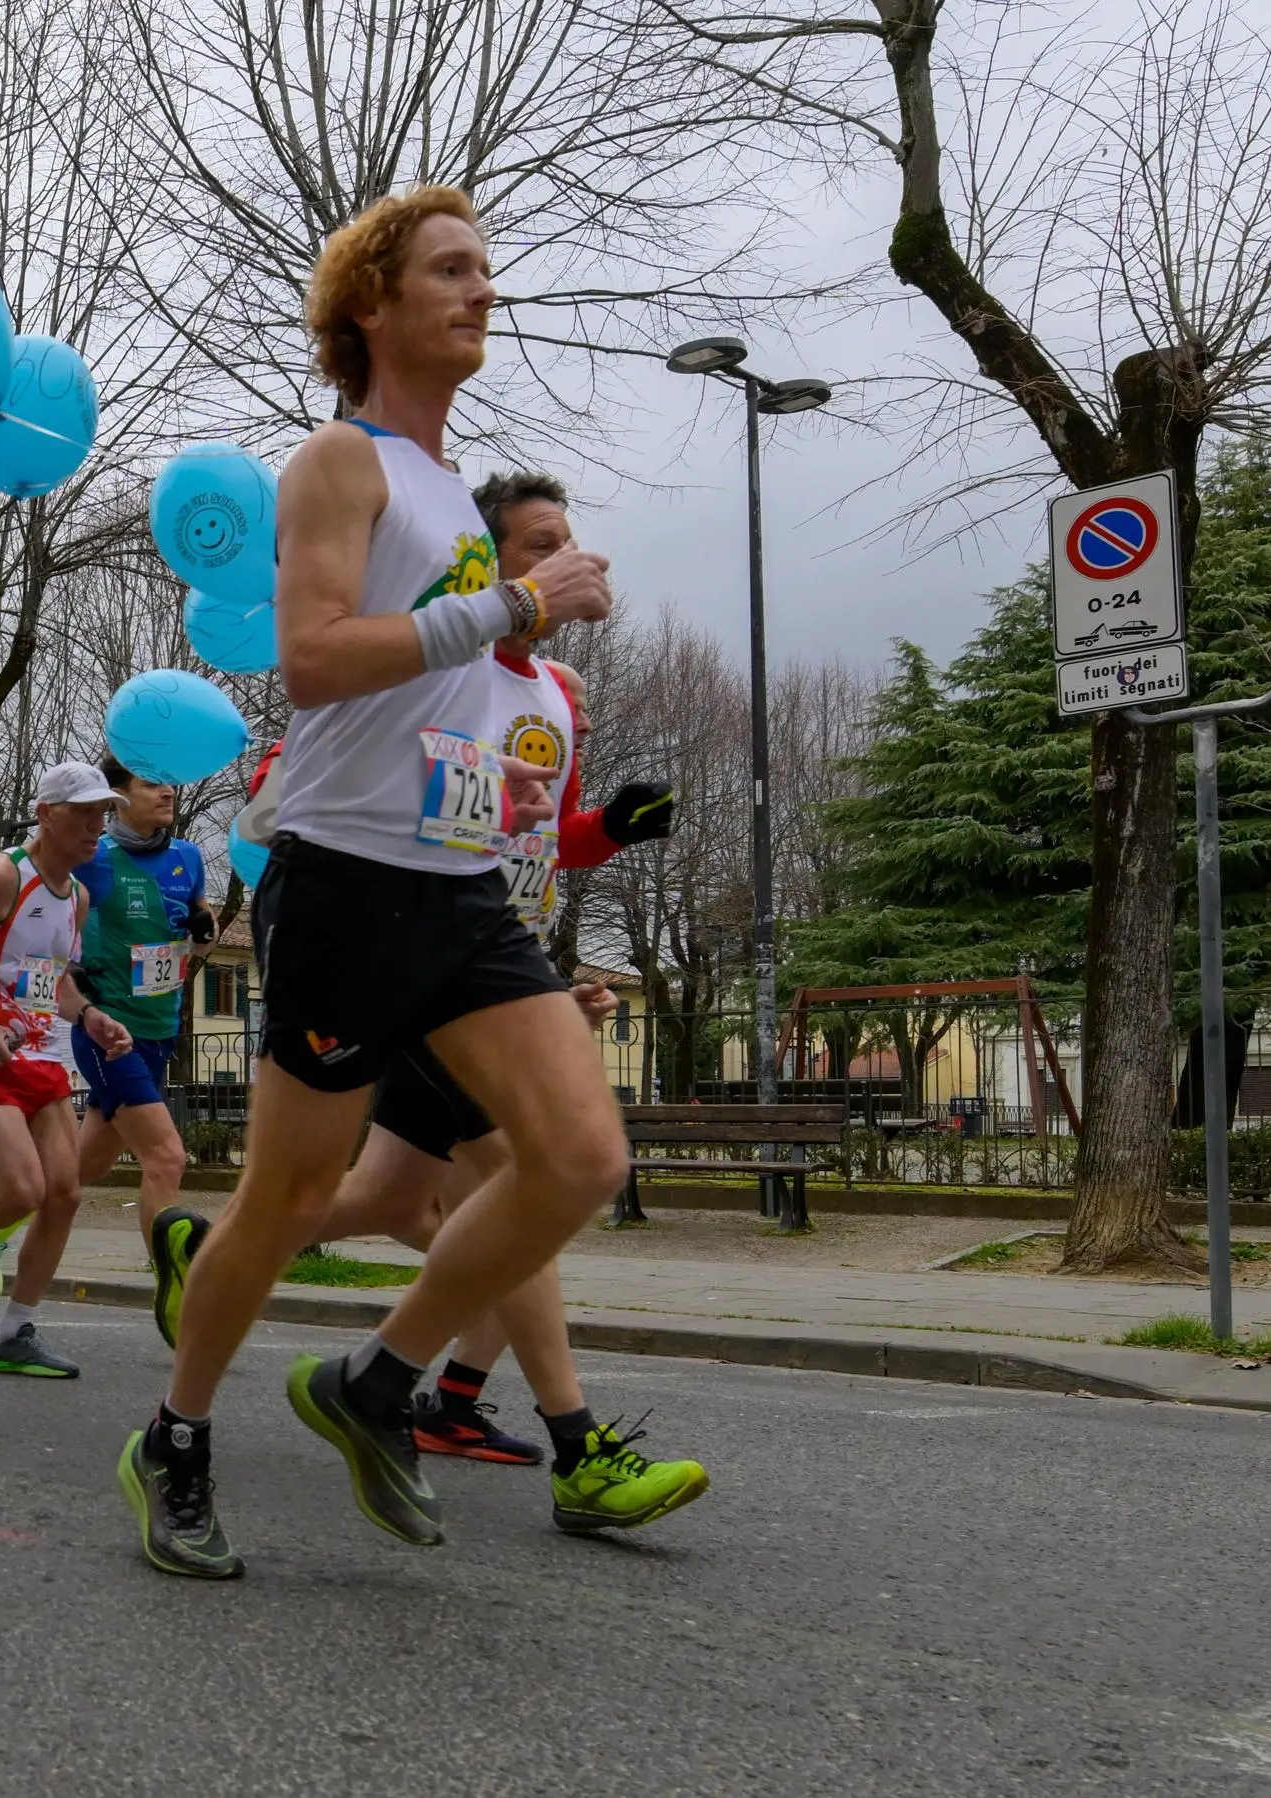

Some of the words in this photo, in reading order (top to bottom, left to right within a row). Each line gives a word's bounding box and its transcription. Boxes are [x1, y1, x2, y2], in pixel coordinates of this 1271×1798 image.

[1083, 661, 1122, 680] fuori
[1134, 655, 1157, 673] dei
[1064, 685, 1109, 705] limiti
[1120, 673, 1180, 696] segnati
[454, 766, 493, 825] 724
[508, 858, 546, 899] 722
[155, 959, 172, 983] 32
[33, 973, 54, 1000] 562
